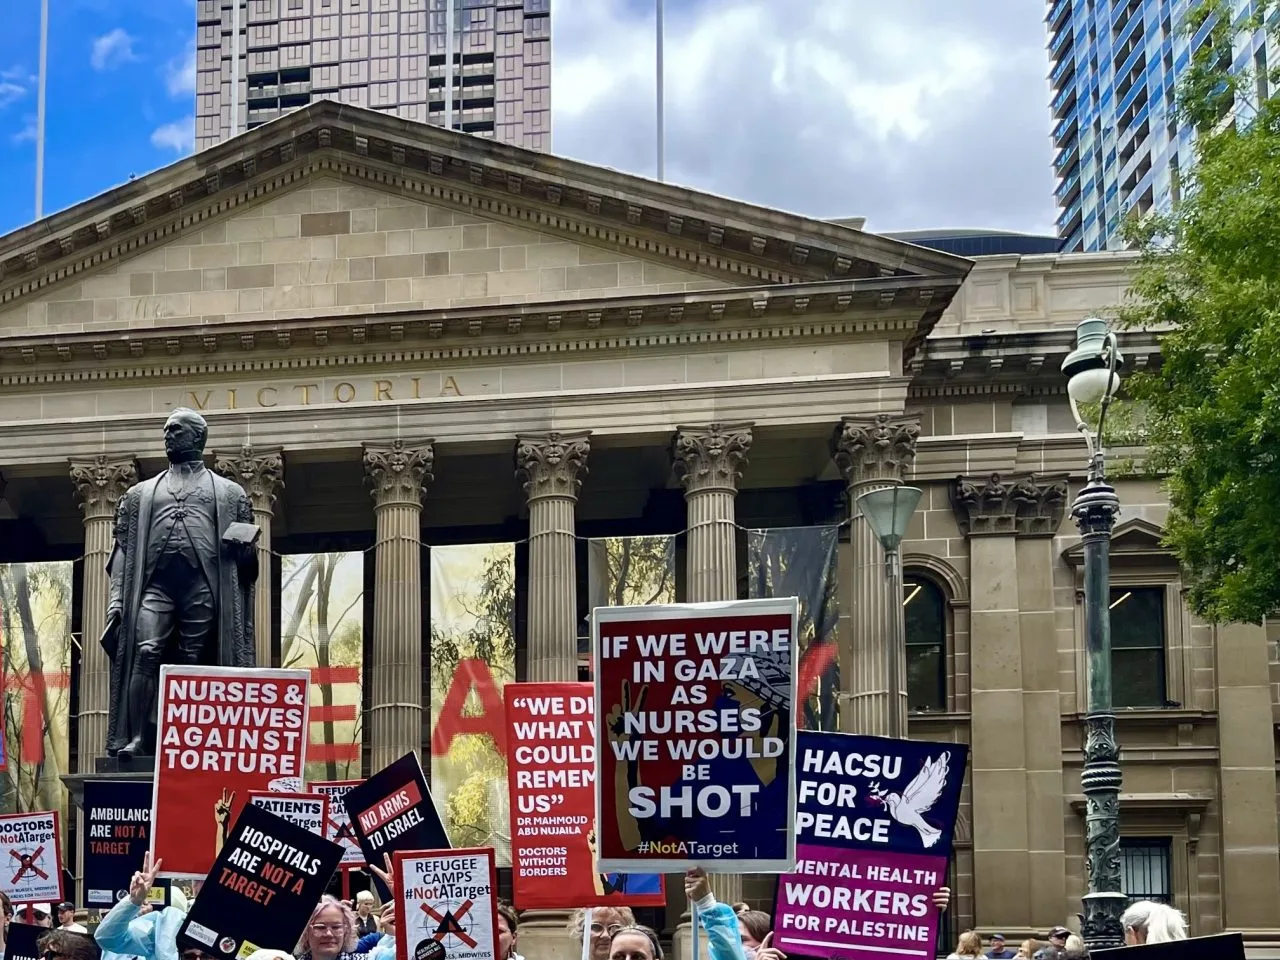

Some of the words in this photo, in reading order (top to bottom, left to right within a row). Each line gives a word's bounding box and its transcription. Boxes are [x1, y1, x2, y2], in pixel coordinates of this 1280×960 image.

[188, 376, 464, 411] VICTORIA
[602, 636, 628, 658] IF
[636, 634, 686, 657] WE
[694, 629, 789, 655] WERE
[633, 661, 665, 683] IN
[674, 657, 759, 682] GAZA
[169, 680, 280, 703] NURSES
[284, 684, 304, 705] &
[671, 685, 707, 705] AS
[164, 702, 302, 729] MIDWIVES
[624, 708, 761, 734] NURSES
[163, 725, 301, 752] AGAINST
[513, 721, 583, 739] WHAT
[165, 747, 295, 775] TORTURE
[611, 740, 658, 761] WE
[667, 738, 784, 760] WOULD
[682, 765, 710, 781] BE
[802, 749, 903, 780] HACSU
[628, 785, 759, 819] SHOT
[799, 780, 857, 808] FOR
[361, 814, 379, 831] NO
[380, 790, 411, 820] ARMS
[517, 817, 531, 826] DR
[534, 816, 588, 825] MAHMOUD
[367, 835, 384, 850] TO
[384, 808, 425, 841] ISRAEL
[518, 827, 539, 836] ABU
[796, 813, 891, 843] PEACE
[239, 826, 321, 876] HOSPITALS
[519, 847, 567, 856] DOCTORS
[637, 841, 738, 854] #NotATarget
[227, 847, 261, 874] ARE
[260, 861, 292, 889] NOT
[292, 878, 305, 896] A
[416, 858, 477, 873] REFUGEE
[519, 857, 567, 866] WITHOUT
[519, 867, 567, 877] BORDERS
[218, 867, 276, 907] TARGET
[423, 872, 472, 884] CAMPS
[866, 865, 937, 886] HEALTH
[405, 884, 491, 899] #NotATarget
[785, 882, 928, 917] WORKERS
[783, 913, 820, 933] FOR
[825, 917, 929, 942] PALESTINE
